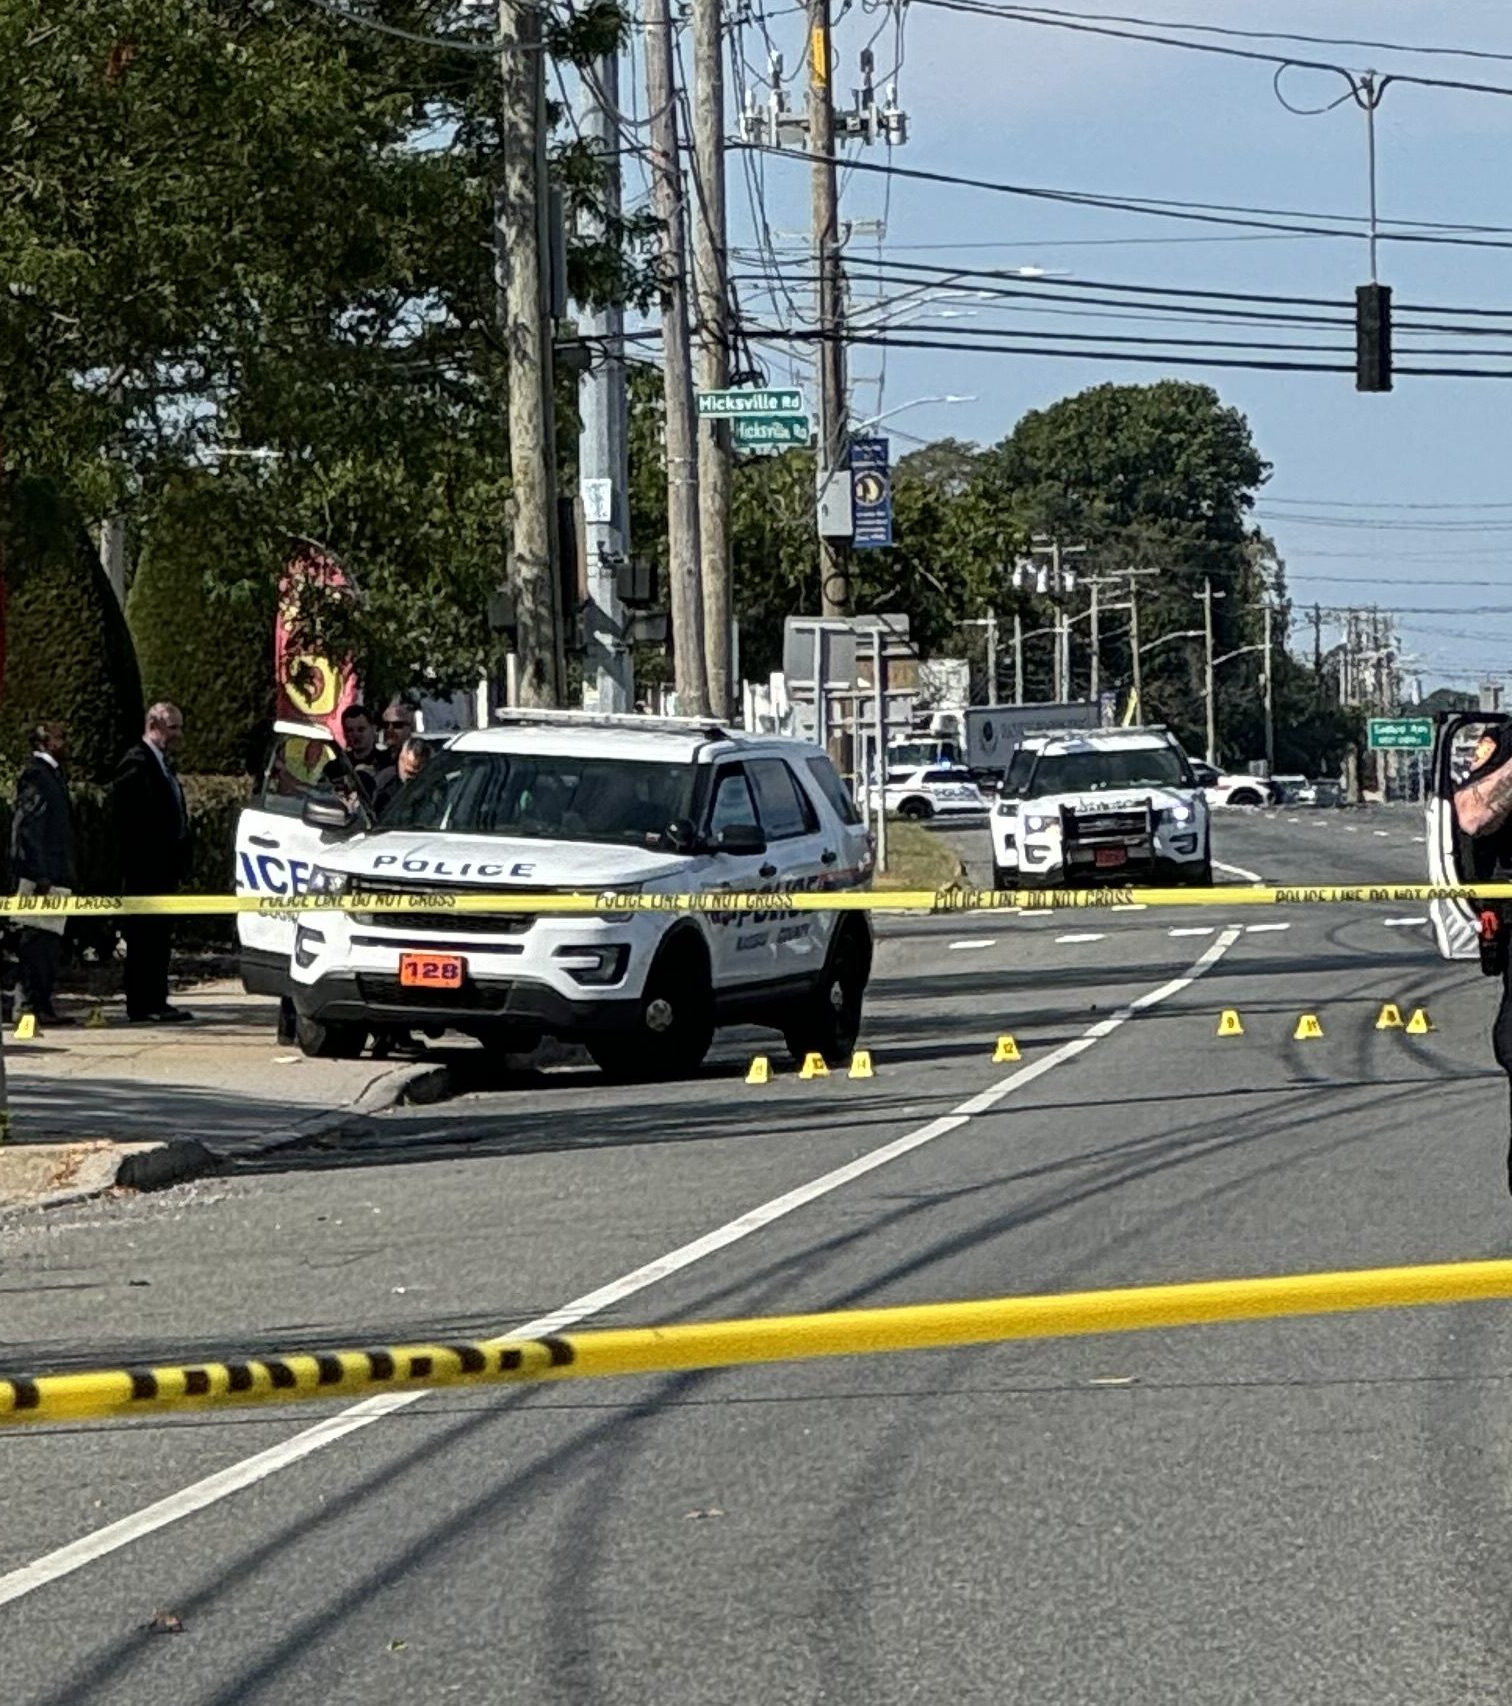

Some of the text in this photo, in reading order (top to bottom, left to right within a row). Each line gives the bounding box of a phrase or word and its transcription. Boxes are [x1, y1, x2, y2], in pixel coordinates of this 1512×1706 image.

[699, 394, 800, 411] Hicksville Rd
[236, 851, 309, 896] ICE
[373, 855, 536, 877] POLICE
[17, 896, 37, 910] DO
[40, 896, 70, 910] NOT
[74, 896, 123, 909] CROSS
[935, 890, 1135, 908] POLICE LINE DO NOT CROSS
[404, 961, 459, 980] 128
